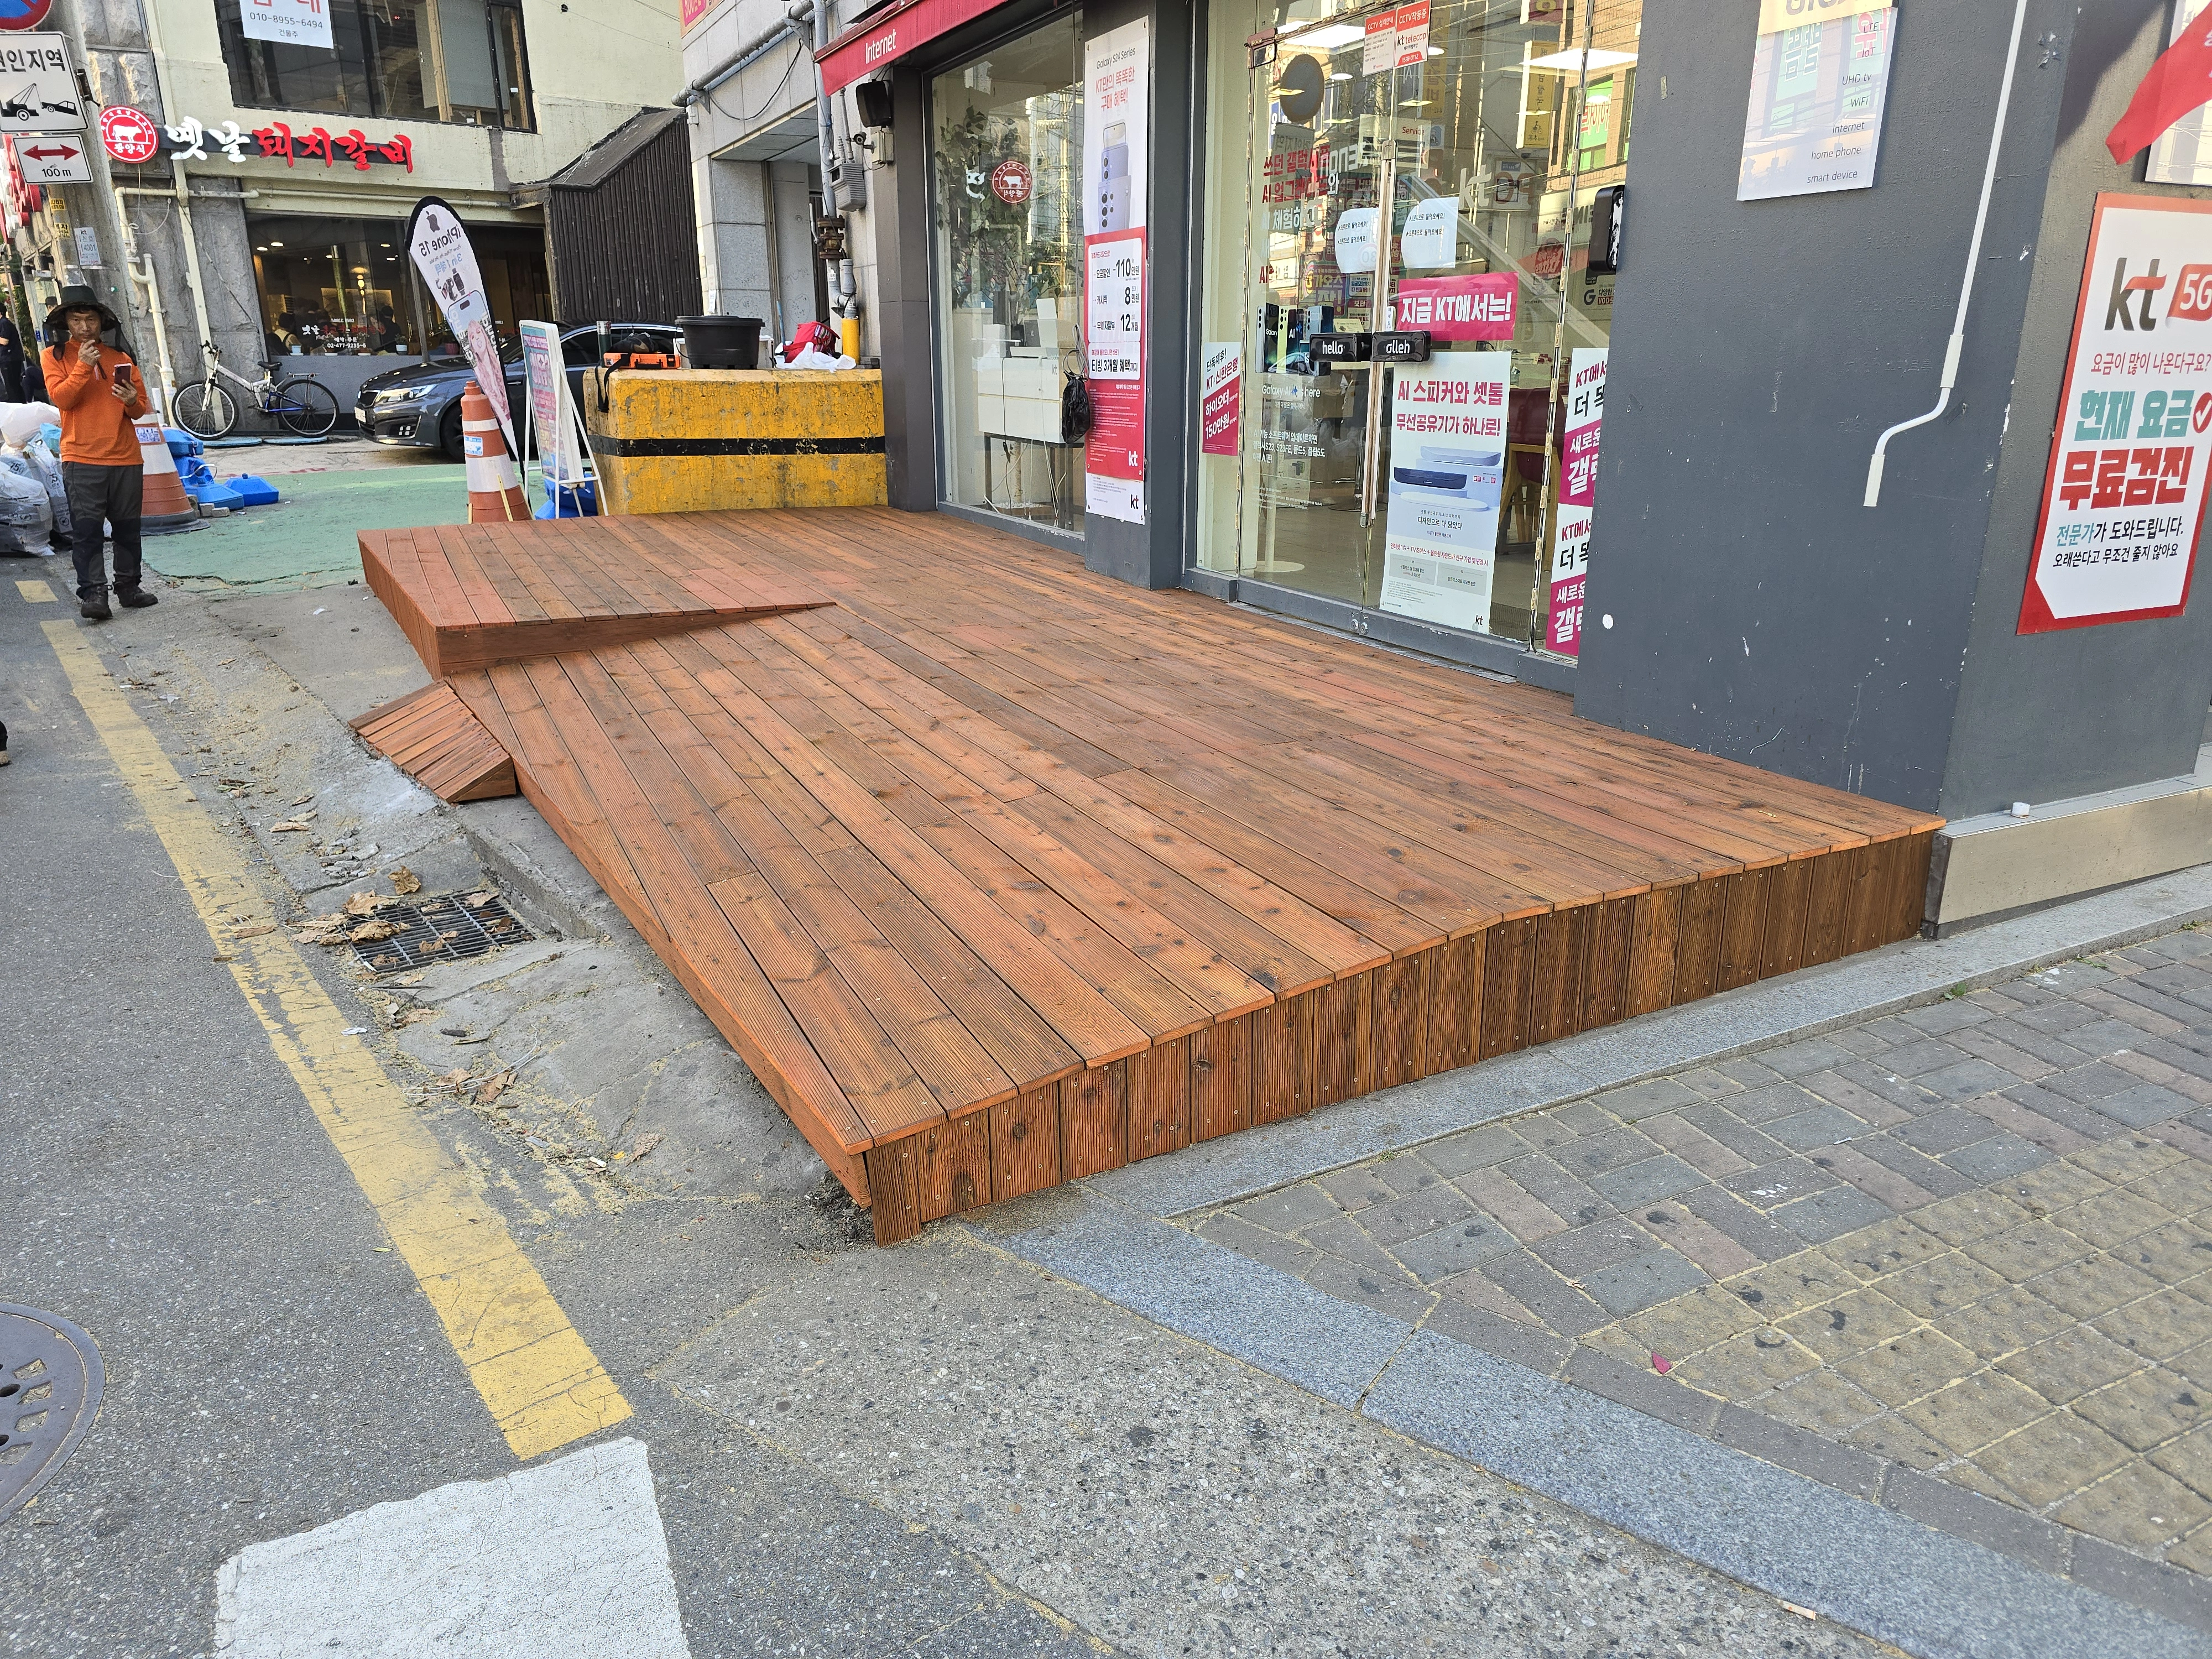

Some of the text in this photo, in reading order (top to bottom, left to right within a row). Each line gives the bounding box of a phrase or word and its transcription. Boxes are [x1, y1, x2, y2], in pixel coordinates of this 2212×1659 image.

[250, 12, 323, 28] 010-8955-6494
[1863, 22, 1879, 34] LTE
[865, 28, 897, 65] Internet
[1397, 33, 1426, 46] kt telecop
[1096, 54, 1112, 69] Galaxy
[1121, 47, 1135, 60] Series
[1861, 46, 1876, 59] IoT
[1095, 74, 1114, 94] KT만의
[1842, 73, 1872, 85] UHD tv
[1101, 87, 1128, 110] 구매 혜택!
[1851, 96, 1869, 108] WiFi
[1832, 121, 1865, 134] internet
[114, 143, 145, 155] 광양식
[165, 116, 250, 162] 옛날
[252, 122, 413, 173] 돼지갈비
[1811, 146, 1861, 160] home phone
[41, 168, 60, 178] 100
[1807, 170, 1858, 184] smart device
[1459, 164, 1492, 211] kt
[1125, 286, 1130, 305] 8
[2104, 257, 2167, 331] kt
[1401, 296, 1431, 324] 지금
[1435, 291, 1512, 322] KT에서는!
[1120, 314, 1130, 332] 12
[1288, 328, 1295, 338] AI
[1322, 341, 1343, 354] hello
[1386, 340, 1410, 354] olleh
[1103, 359, 1118, 372] 3개월
[1207, 348, 1227, 372] 단독제휴!
[2091, 352, 2211, 375] 요금이 많이 나온다구요?
[1206, 357, 1238, 390] KT 신한은행
[1262, 384, 1283, 398] Galaxy
[1305, 385, 1321, 398] here
[1397, 380, 1503, 406] AI 스피커와 셋톱
[1206, 389, 1229, 417] 하이오더
[1574, 391, 1589, 417] 더
[2074, 389, 2195, 441] 현재 요금
[1206, 411, 1229, 440] 150만원
[1396, 413, 1501, 437] 무선공유기가 하나로!
[1269, 430, 1290, 442] 소프트웨어
[1291, 432, 1318, 445] 업데이트하면
[1276, 443, 1292, 455] S23FE,
[1128, 450, 1138, 467] kt
[2059, 446, 2194, 512] 무료검진
[1130, 494, 1139, 509] kt
[1417, 517, 1463, 530] 디자인으로 다 담았다
[2057, 515, 2184, 547] 전문가가 도와드립니다.
[1559, 545, 1575, 570] 더
[2053, 542, 2179, 568] 오래쓴다고 무조건 줄지 않아요
[1475, 615, 1483, 625] kt
